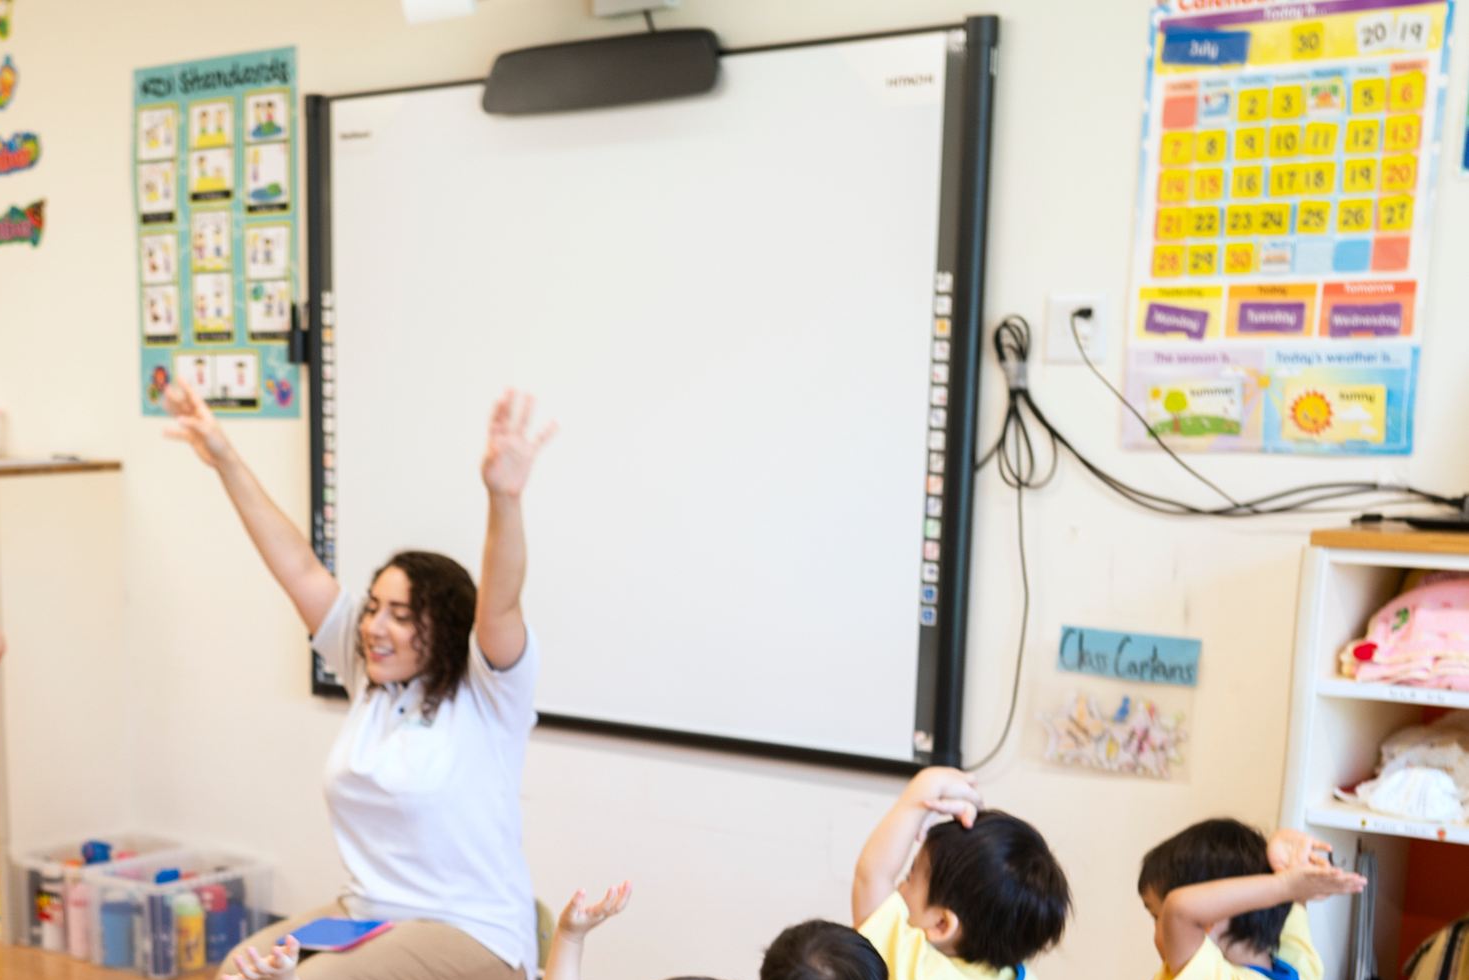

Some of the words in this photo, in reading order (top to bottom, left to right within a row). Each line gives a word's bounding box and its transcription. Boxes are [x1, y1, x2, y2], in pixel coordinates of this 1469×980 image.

[1263, 7, 1304, 20] Today
[1296, 31, 1321, 54] 30
[1361, 23, 1387, 46] 20
[1399, 21, 1424, 43] 19
[1188, 38, 1219, 60] July
[1246, 96, 1259, 116] 2
[1282, 94, 1294, 113] 3
[1362, 88, 1375, 108] 5
[1400, 83, 1414, 104] 6
[1170, 141, 1183, 158] 7
[1205, 137, 1218, 156] 8
[1243, 135, 1256, 153] 9
[1275, 132, 1297, 151] 10
[1312, 131, 1331, 150] 11
[1353, 128, 1375, 148] 12
[1391, 124, 1414, 144] 13
[1199, 176, 1221, 195] 15
[1236, 173, 1258, 192] 16
[1277, 171, 1297, 190] 17
[1304, 170, 1326, 189] 18
[1351, 166, 1372, 185] 19
[1386, 164, 1412, 184] 20
[1162, 215, 1183, 234] 21
[1194, 213, 1217, 232] 22
[1229, 211, 1253, 231] 23
[1260, 210, 1283, 229] 24
[1302, 208, 1326, 228] 25
[1342, 207, 1366, 227] 26
[1384, 202, 1408, 225] 27
[1157, 252, 1180, 272] 28
[1191, 251, 1214, 271] 29
[1227, 249, 1253, 269] 30
[1343, 282, 1396, 293] Tomorrow
[1152, 309, 1201, 334] Monday
[1246, 308, 1298, 327] Tuesday
[1332, 313, 1401, 328] Wednesday
[1154, 352, 1175, 364] The
[1177, 353, 1219, 365] season
[1275, 351, 1323, 366] Today's
[1326, 351, 1378, 364] weather
[1339, 390, 1376, 403] sunny
[1060, 627, 1108, 672] Class
